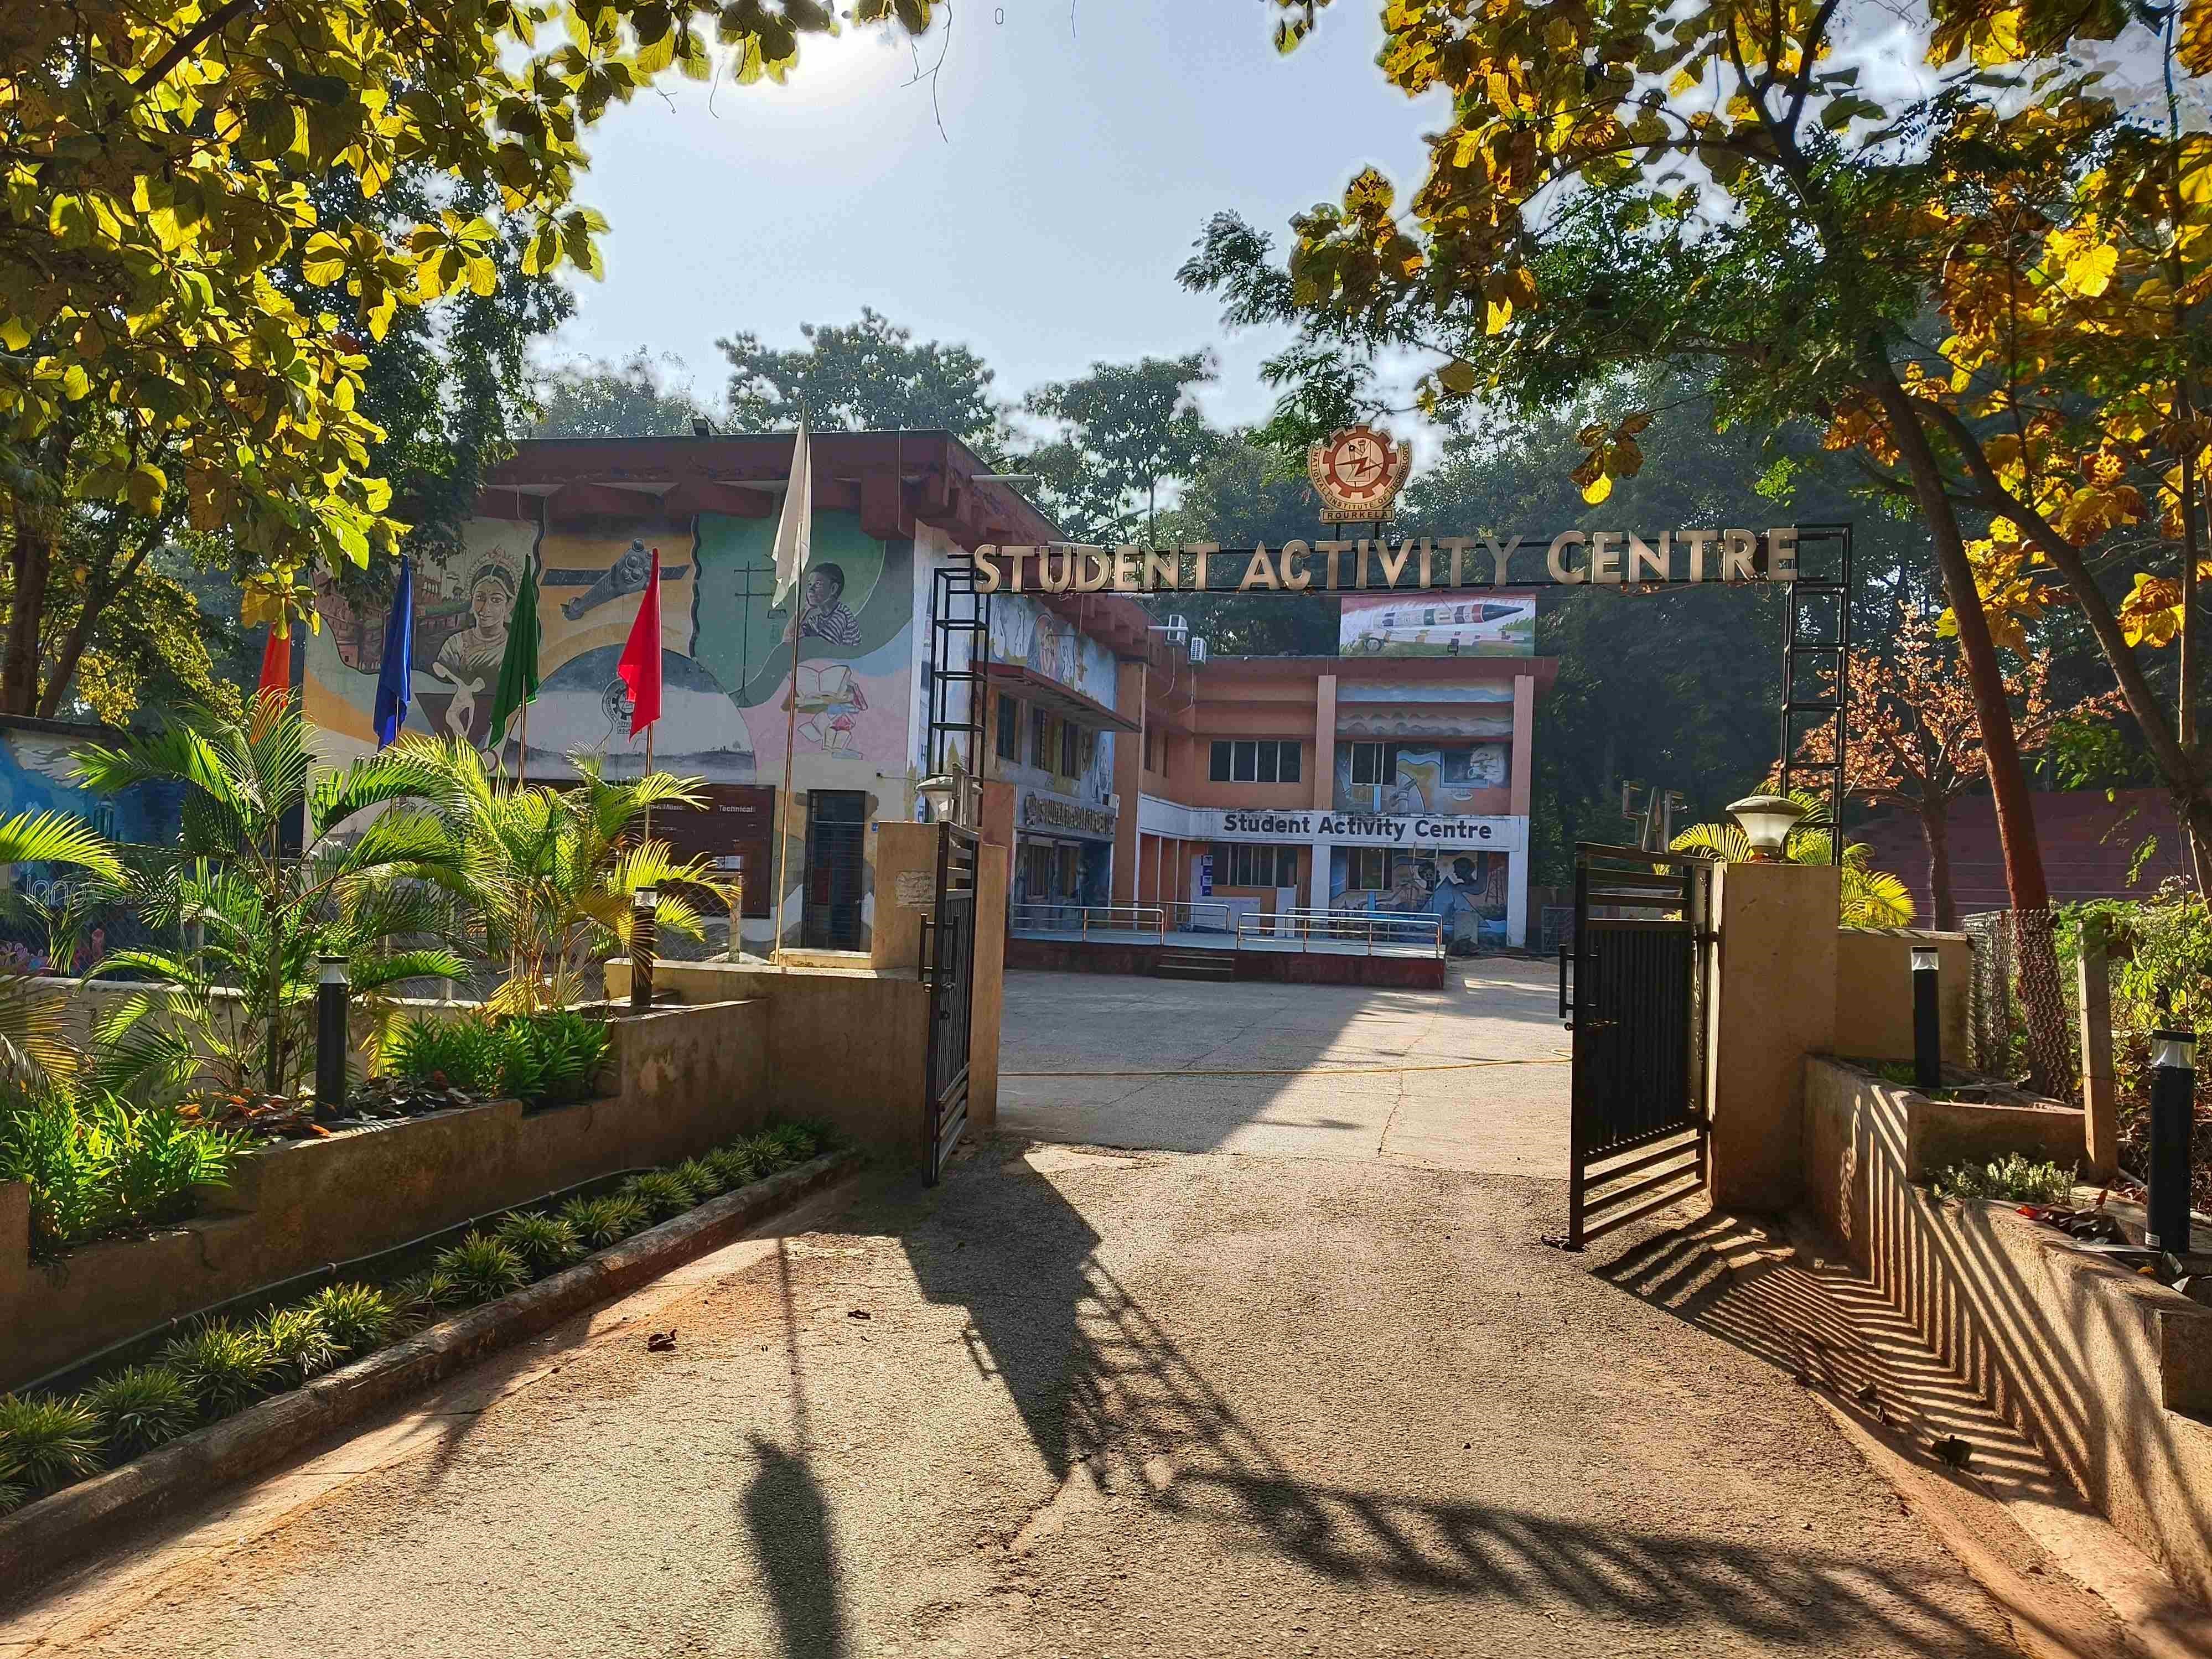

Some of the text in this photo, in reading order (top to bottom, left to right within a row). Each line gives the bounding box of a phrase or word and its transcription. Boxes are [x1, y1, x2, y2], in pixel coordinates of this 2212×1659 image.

[1311, 447, 1409, 509] NATIONAL INSTITUTE OF TECHNOLOGY
[1328, 511, 1388, 520] ROURKELA
[974, 527, 1799, 594] STUDENT ACTIVITY CENTRE
[1224, 814, 1492, 842] Student Activity Centre
